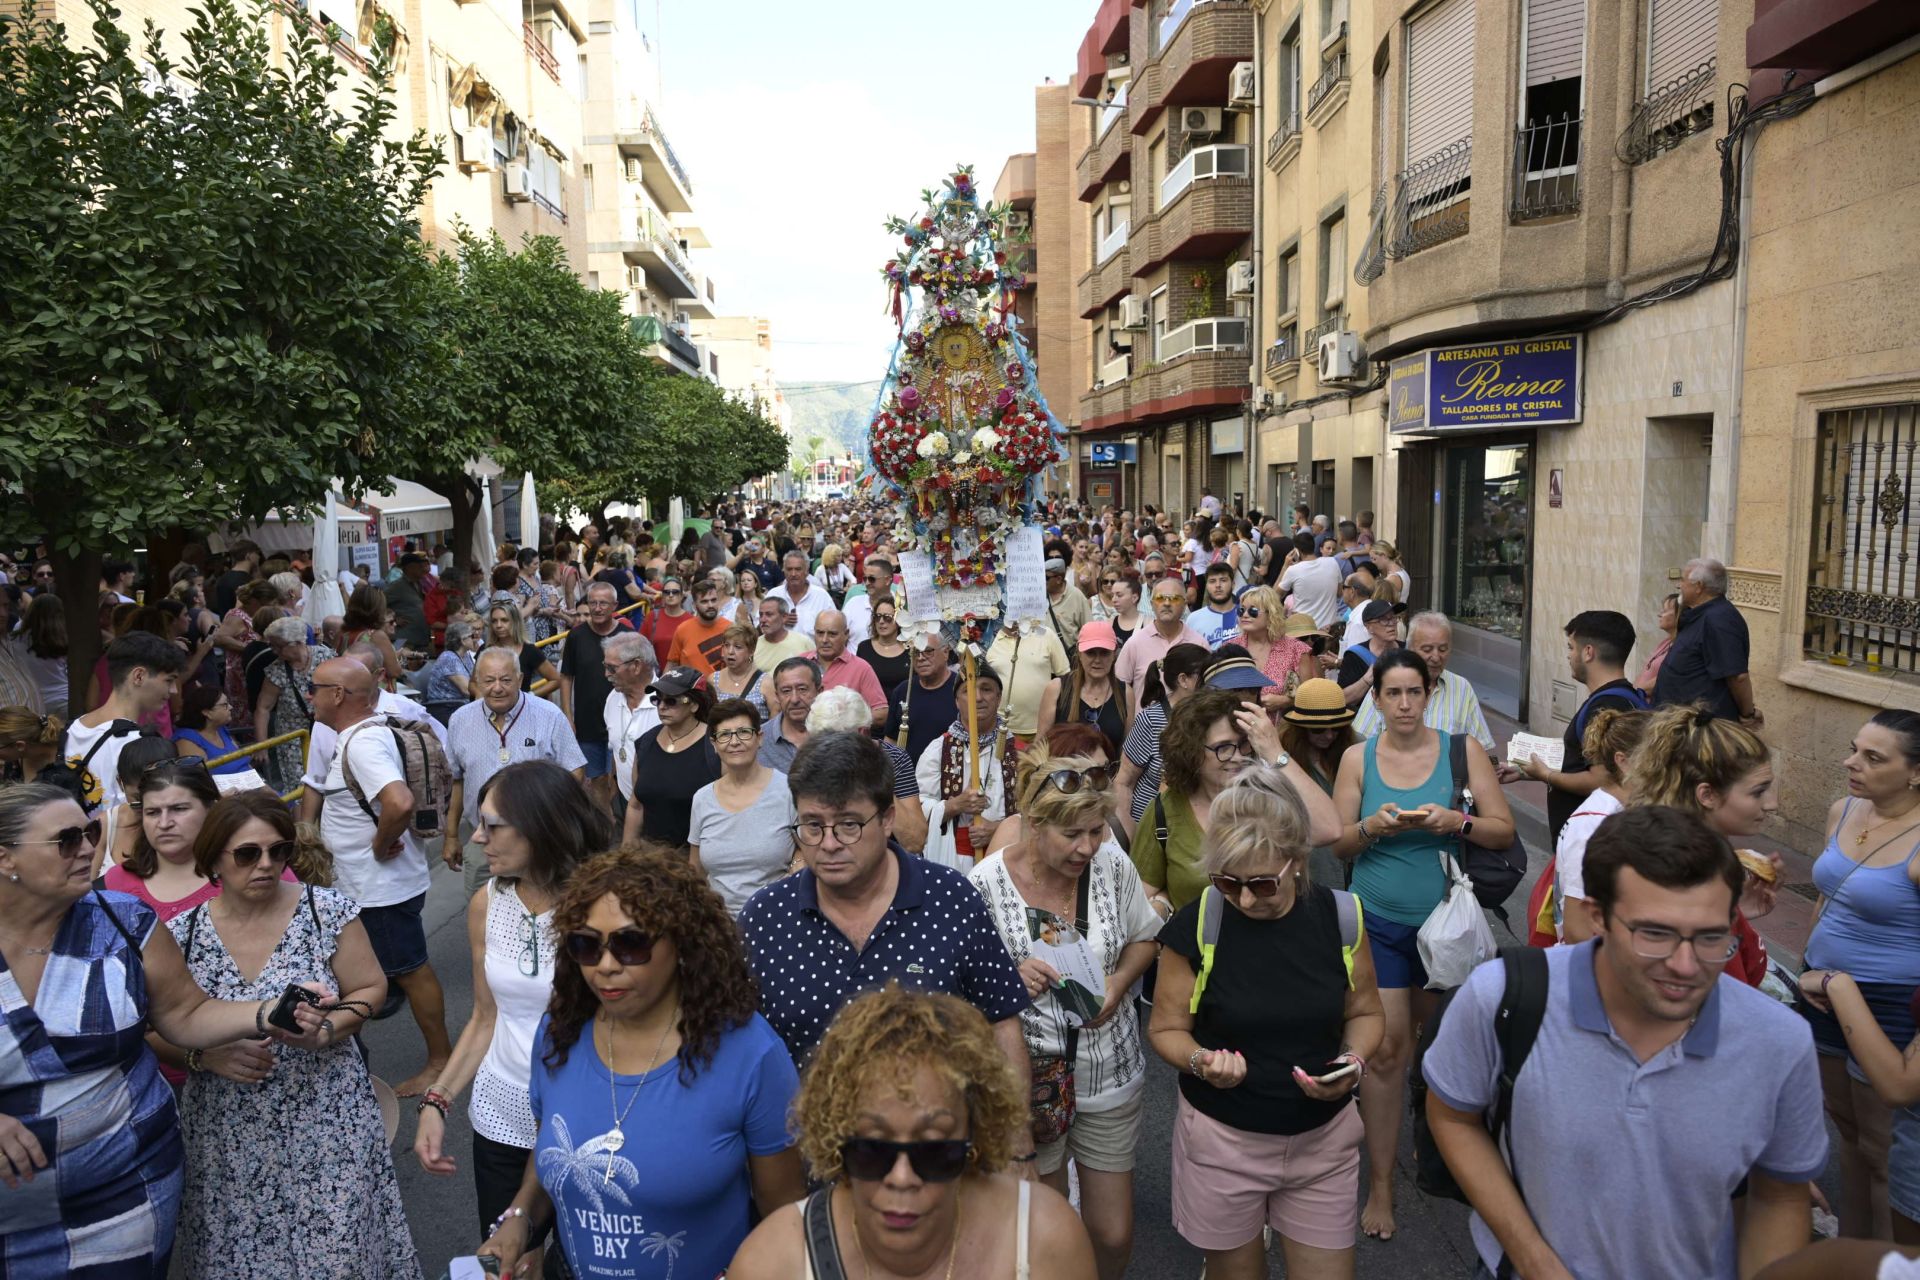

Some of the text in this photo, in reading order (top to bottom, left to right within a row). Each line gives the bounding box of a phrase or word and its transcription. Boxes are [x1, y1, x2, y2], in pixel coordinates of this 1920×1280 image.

[1437, 340, 1572, 362] ARTESANIA EN CRISTAL
[1440, 359, 1566, 403] Reina
[1673, 383, 1682, 396] 12
[1392, 385, 1424, 424] Reina
[1442, 400, 1562, 415] TALLADORES DE CRISTAL
[1104, 446, 1116, 460] S
[574, 1208, 645, 1235] VENICE
[592, 1235, 630, 1260] BAY
[589, 1264, 636, 1278] AMAZING PLACE
